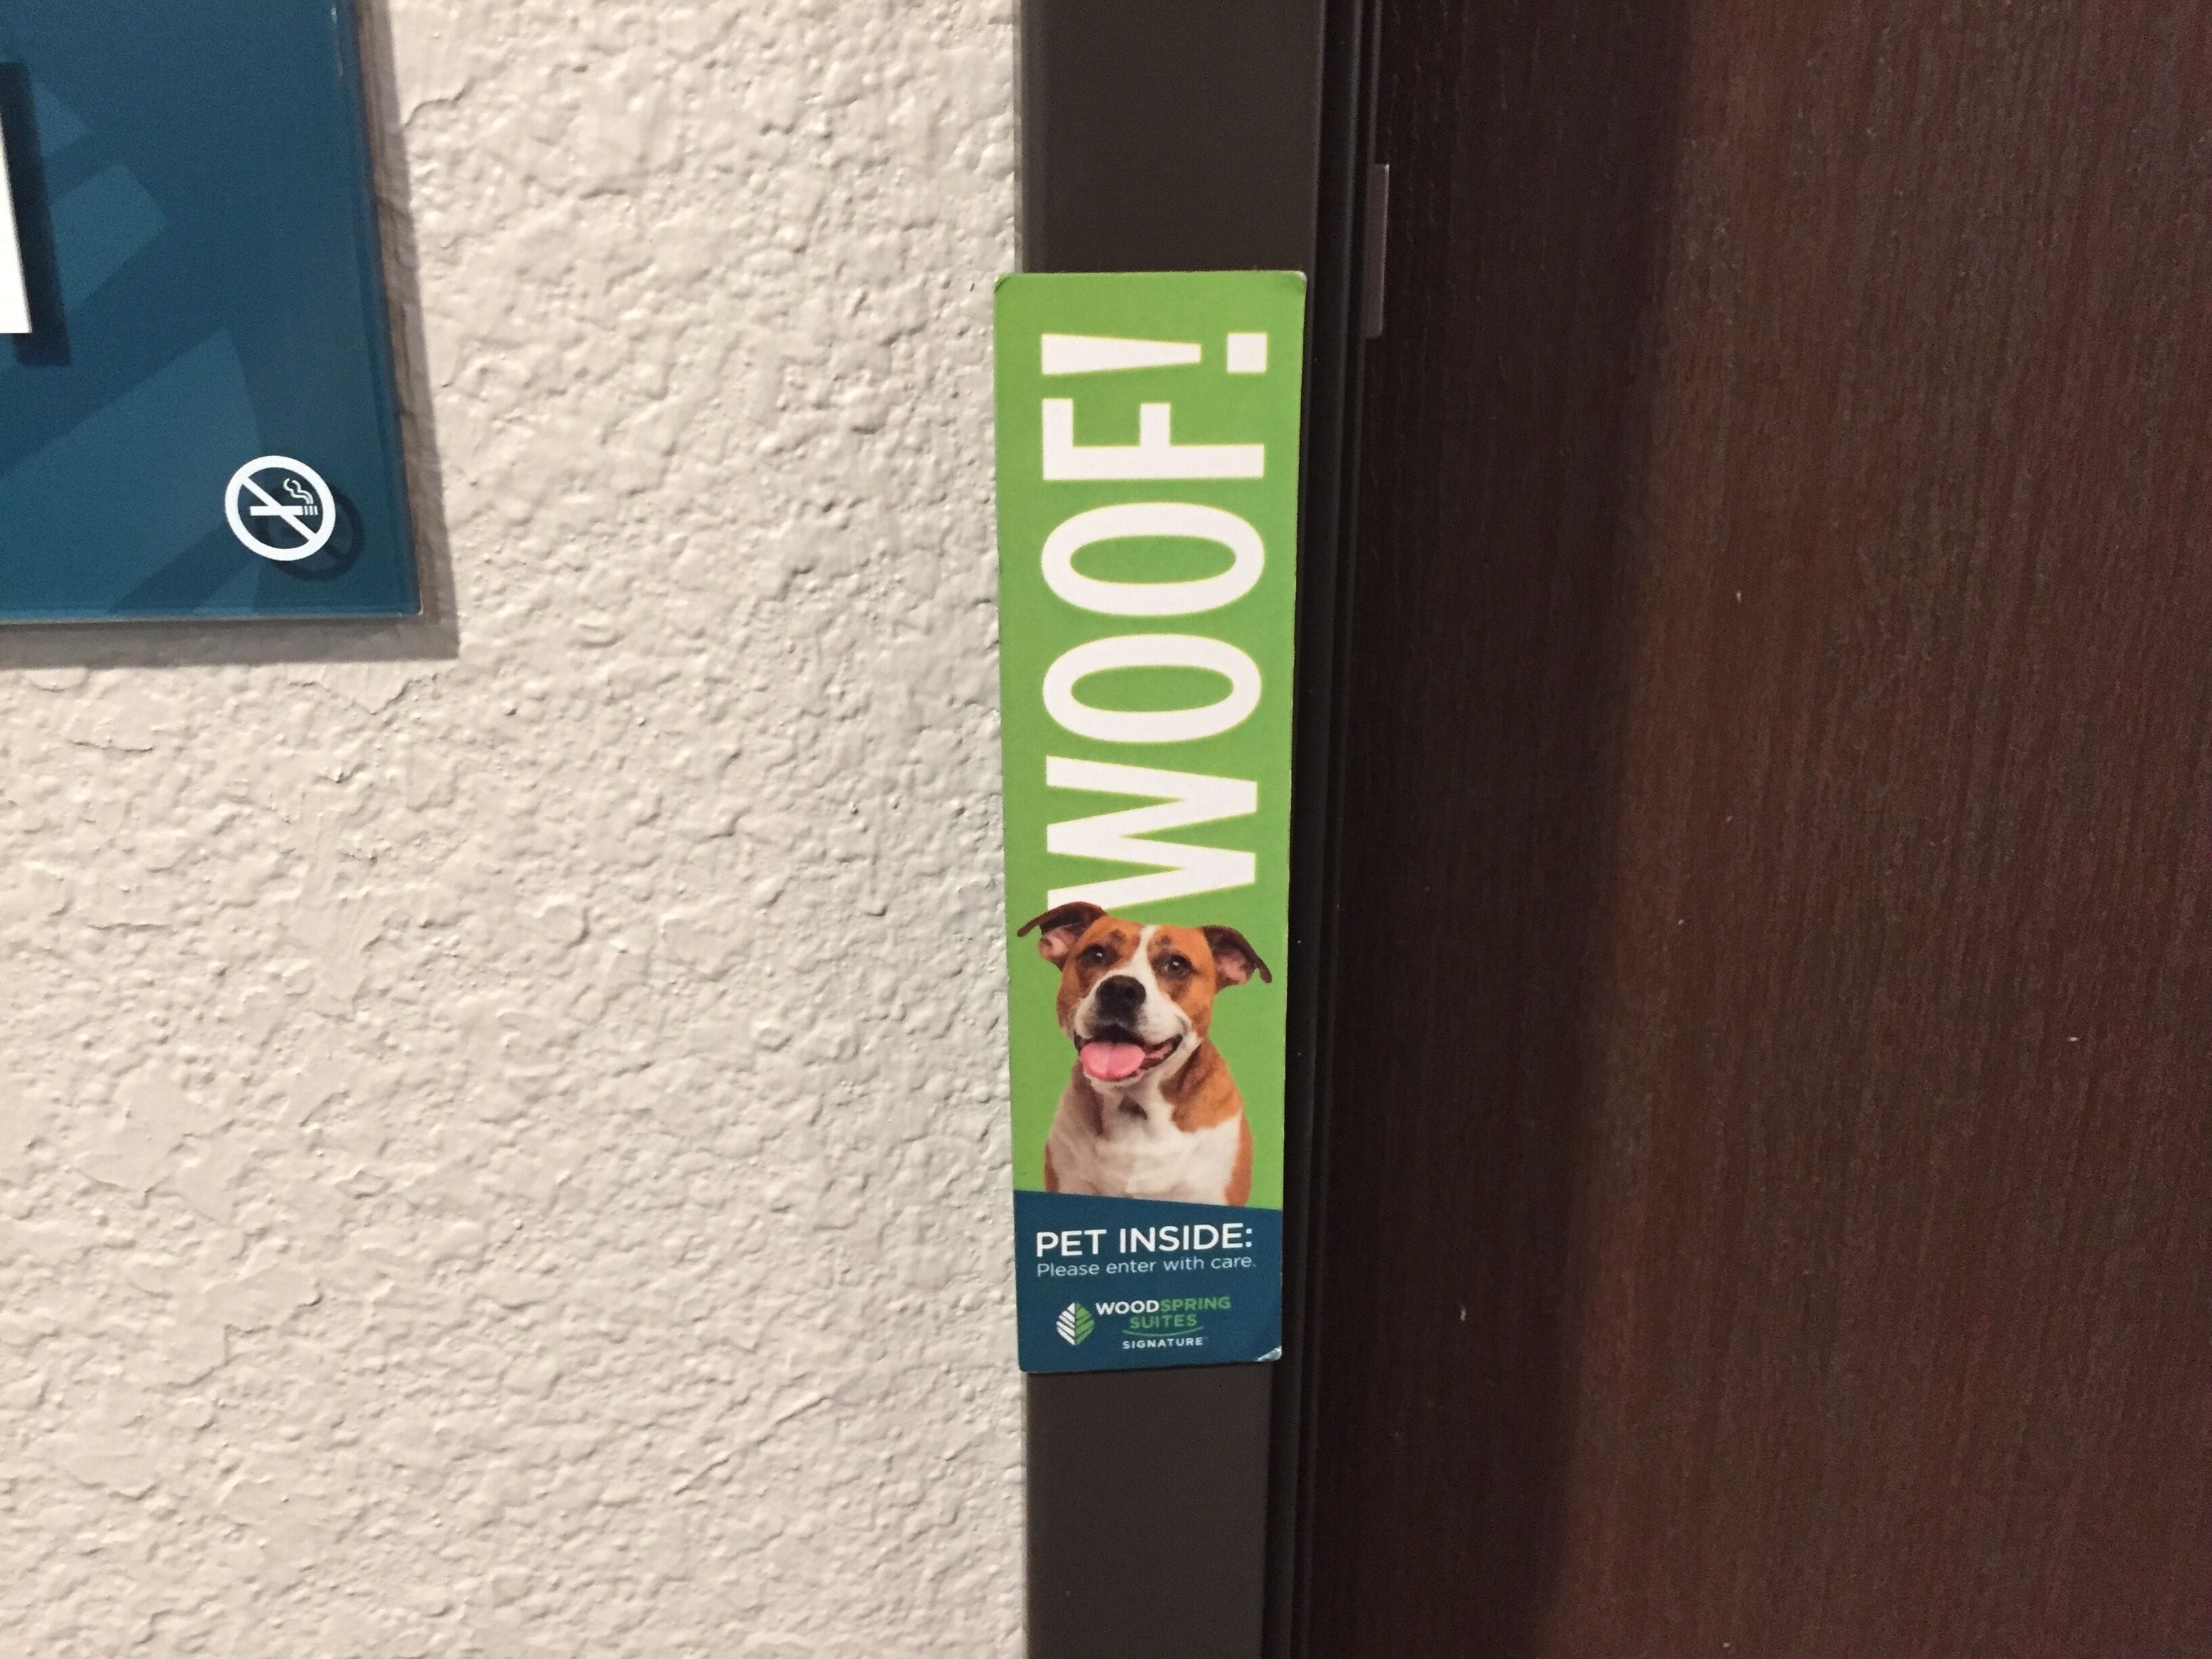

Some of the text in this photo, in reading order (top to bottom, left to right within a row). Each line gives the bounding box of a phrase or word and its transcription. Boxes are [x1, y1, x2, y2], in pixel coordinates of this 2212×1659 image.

[1040, 331, 1269, 910] WOOF!
[1036, 1223, 1253, 1258] PET INSIDE:
[1037, 1256, 1256, 1277] Please enter with care.
[1095, 1296, 1231, 1315] WOODSPRING
[1129, 1314, 1197, 1330] SUITES
[1122, 1336, 1204, 1350] SIGNATURE
